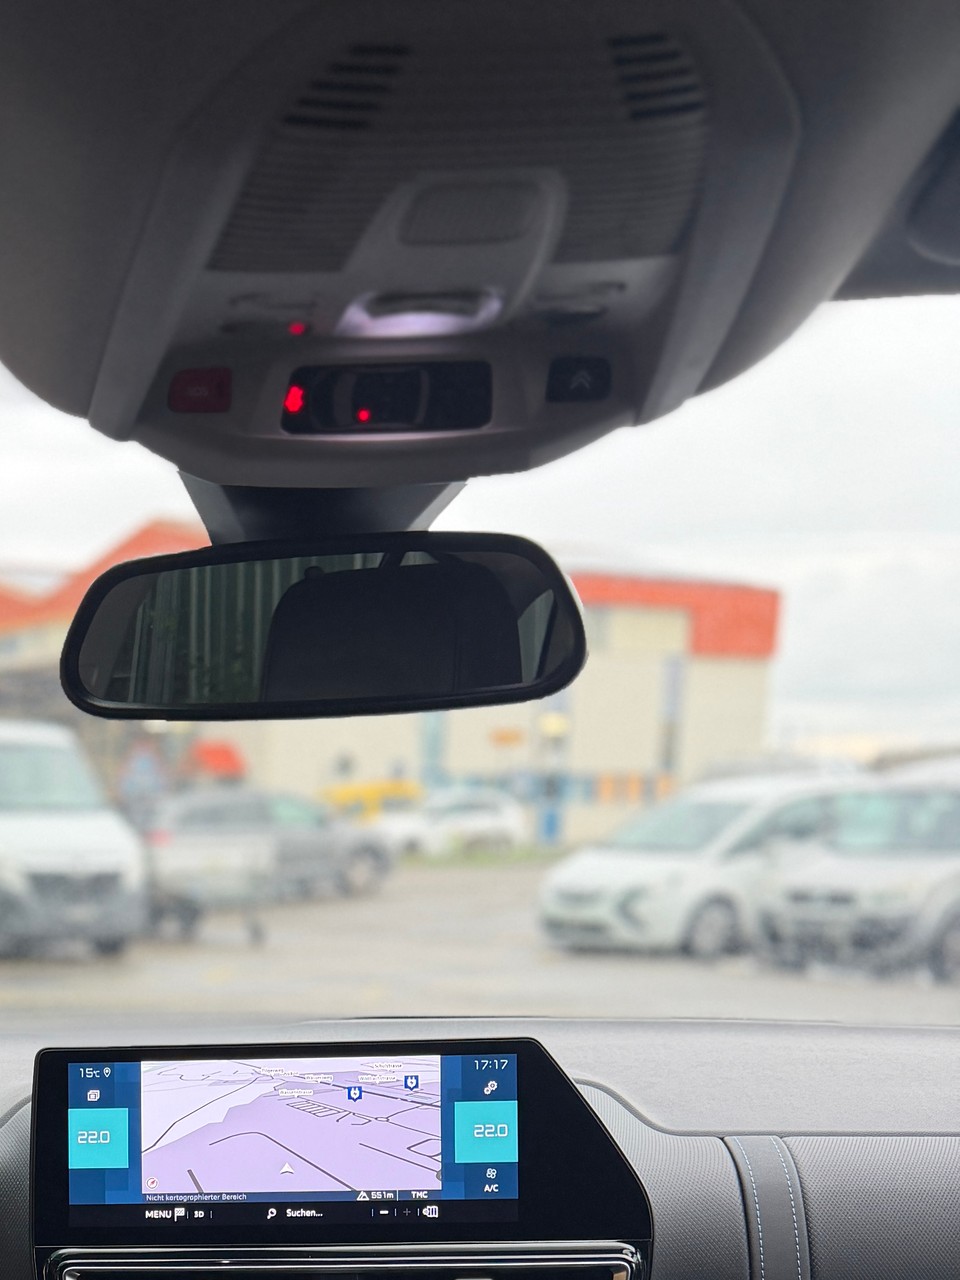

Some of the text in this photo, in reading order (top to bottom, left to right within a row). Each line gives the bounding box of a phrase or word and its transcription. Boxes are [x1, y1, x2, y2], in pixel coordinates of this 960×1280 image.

[474, 1059, 508, 1070] 17:17
[473, 1123, 508, 1138] 22.0
[77, 1130, 110, 1144] 22.0
[484, 1184, 499, 1192] A/C
[165, 1193, 220, 1202] kartographierter
[222, 1193, 247, 1201] Bereich
[411, 1191, 428, 1199] TMC
[145, 1210, 172, 1219] MENU
[286, 1208, 323, 1218] Suchen...
